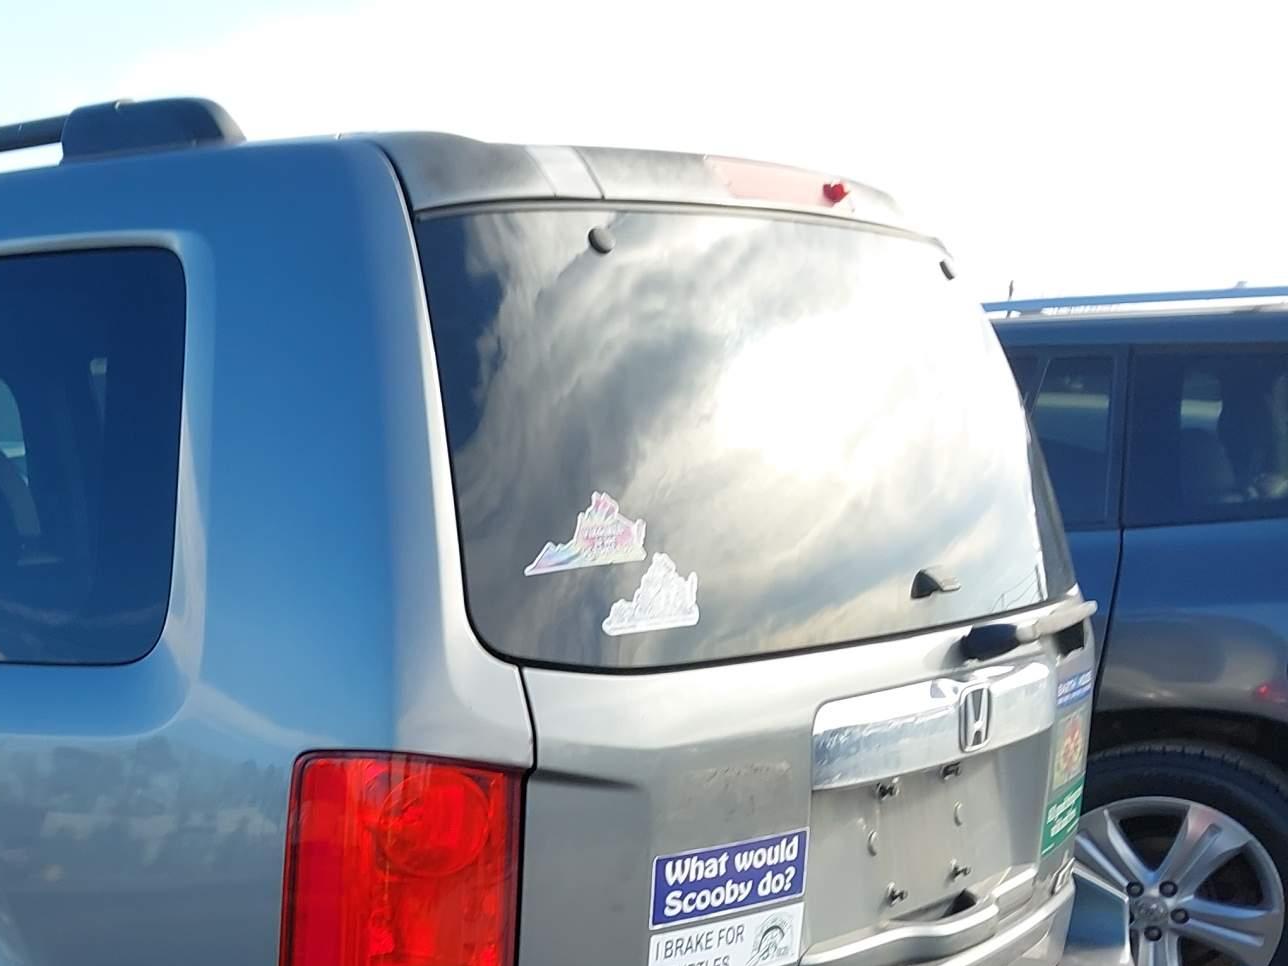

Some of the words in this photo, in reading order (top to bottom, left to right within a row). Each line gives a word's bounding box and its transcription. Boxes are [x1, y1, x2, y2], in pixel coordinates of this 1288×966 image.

[665, 853, 729, 886] What
[735, 835, 799, 870] would
[663, 879, 753, 918] Scooby
[757, 866, 796, 895] do?
[664, 932, 713, 959] BRAKE
[717, 924, 744, 947] FOR
